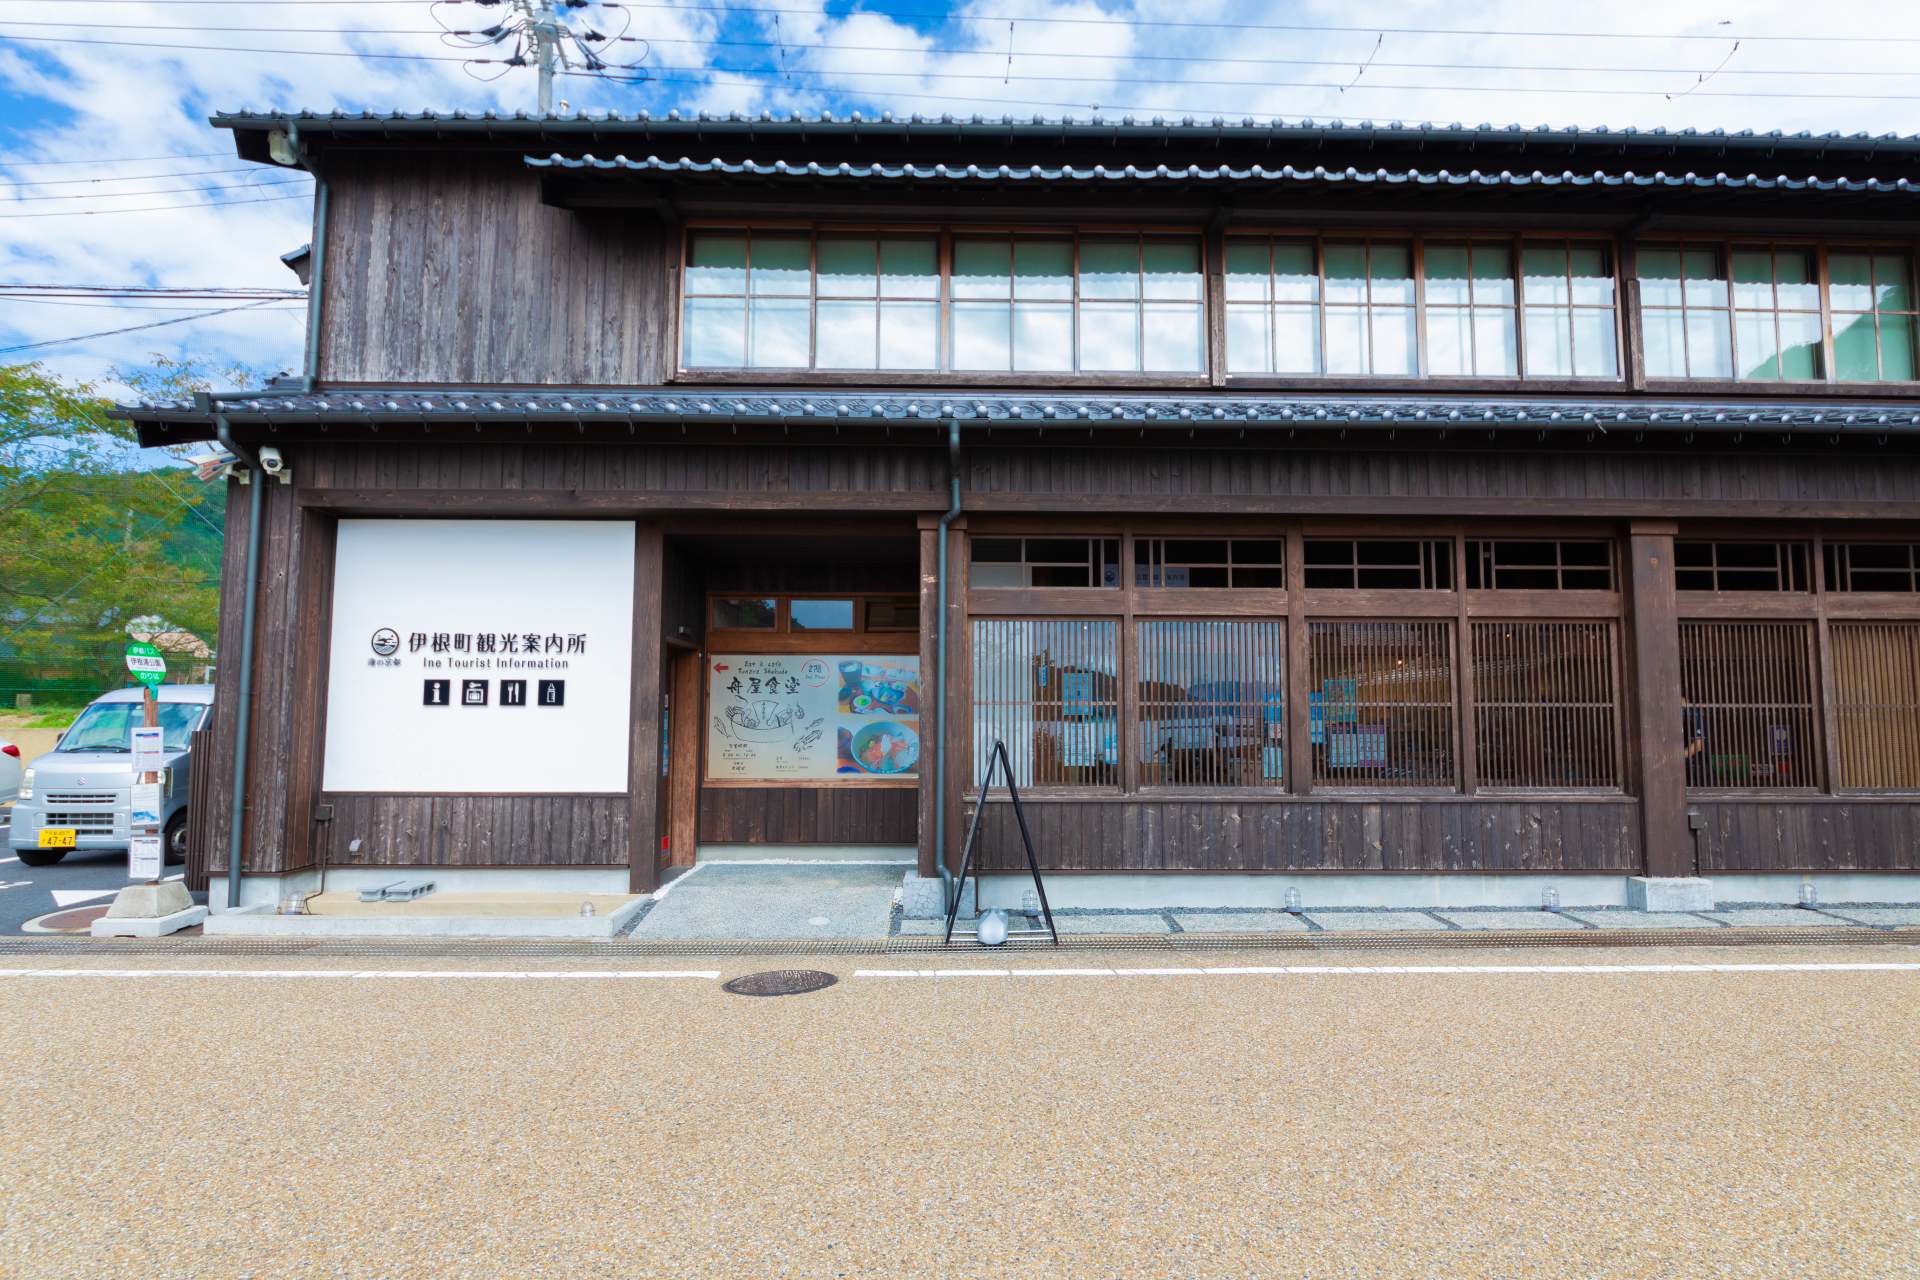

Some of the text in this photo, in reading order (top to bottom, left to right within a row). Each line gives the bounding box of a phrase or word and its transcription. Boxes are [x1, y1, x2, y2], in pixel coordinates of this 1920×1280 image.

[408, 632, 587, 654] 伊根町観光案内所
[423, 657, 569, 669] Ine Tourist Information
[726, 676, 801, 694] 舟屋食堂
[47, 836, 72, 846] 47-47
